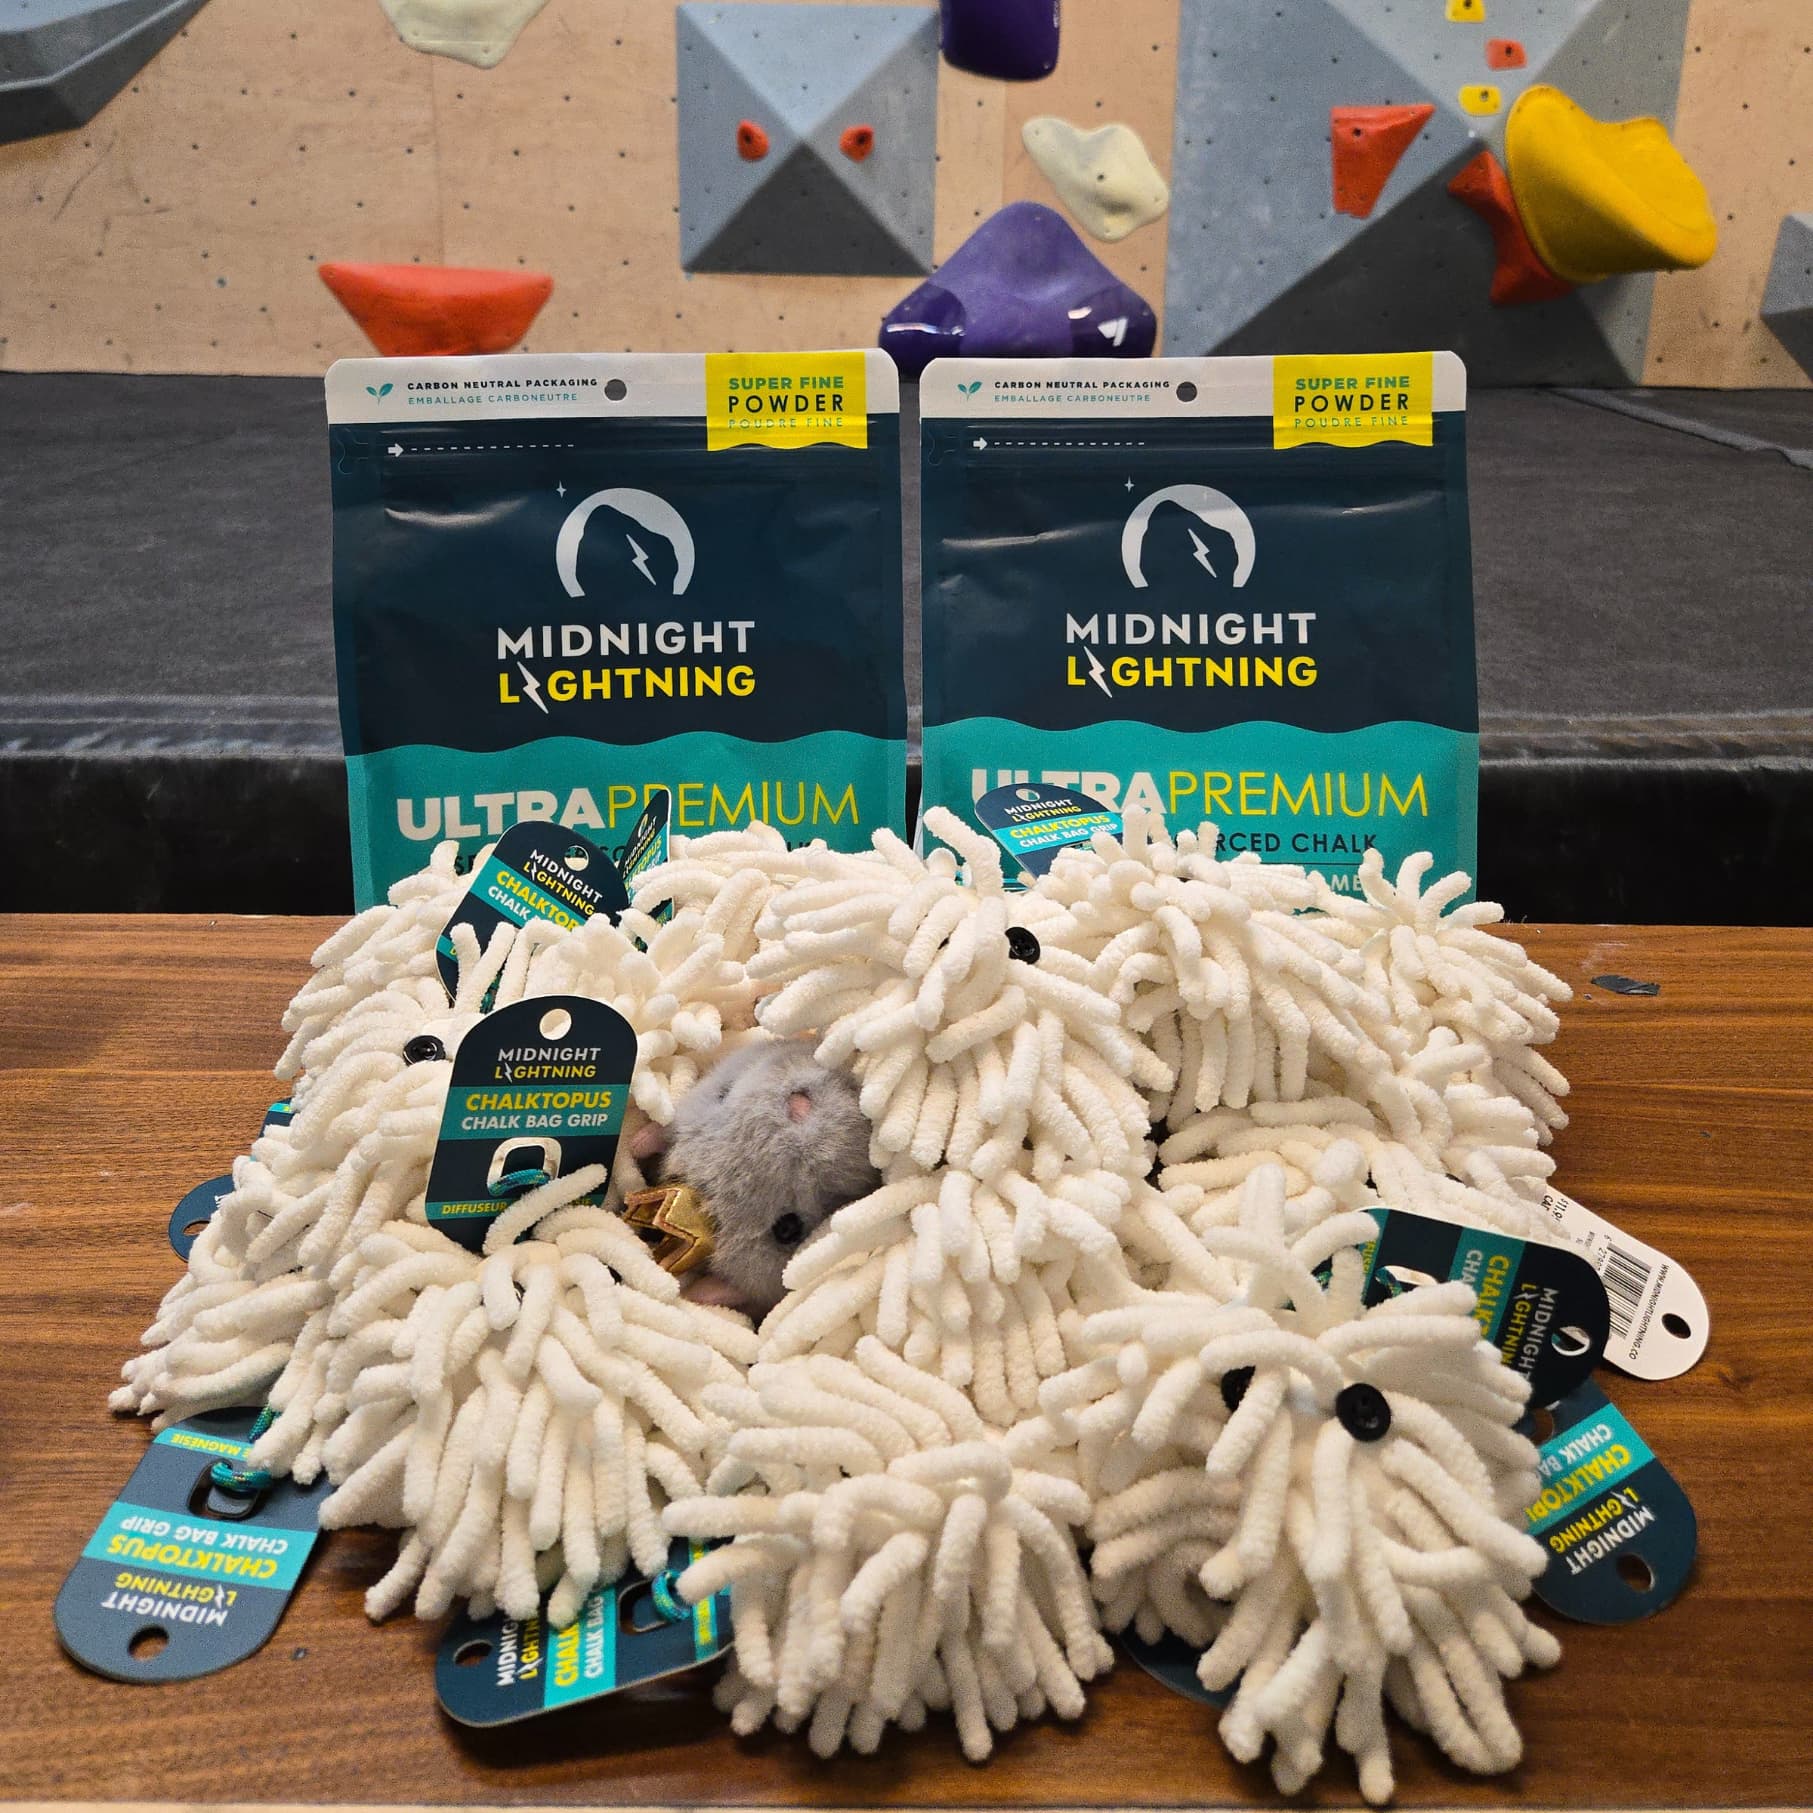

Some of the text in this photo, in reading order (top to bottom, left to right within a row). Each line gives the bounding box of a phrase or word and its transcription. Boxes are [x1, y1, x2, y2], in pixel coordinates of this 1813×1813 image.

[407, 378, 598, 391] CARBON NEUTRAL PACKAGING
[407, 393, 578, 405] EMBALLAGE CARBONEUTRE
[728, 375, 845, 391] SUPER FINE
[994, 380, 1171, 390] CARBON NEUTRAL PACKAGING
[994, 393, 1152, 403] EMBALLAGE CARBONEUTRE
[1295, 375, 1411, 391] SUPER FINE
[728, 393, 846, 414] POWDER
[1294, 393, 1410, 413] POWDER
[728, 415, 845, 430] POUDRE FINE
[1294, 414, 1410, 429] POUDRE FINE
[498, 620, 756, 660] MIDNIGHT
[1066, 612, 1317, 645] MIDNIGHT
[499, 662, 756, 713] LIGHTNING
[1067, 647, 1318, 697] LIGHTNING
[1004, 799, 1073, 815] MIDNIGHT
[1012, 806, 1082, 822] LIGHTNING
[1010, 815, 1110, 839] CHALKTOPUS
[1019, 823, 1119, 848] CHALK BAG GRIP
[1291, 833, 1377, 853] CHALK
[522, 861, 596, 917] LIGHTNING
[529, 849, 603, 903] MIDNIGHT
[488, 886, 531, 921] CHALK
[496, 871, 583, 933] CHALKTOP
[497, 1047, 601, 1063] MIDNIGHT
[495, 1063, 597, 1082] LIGHTNING
[465, 1091, 612, 1111] CHALKTOPUS
[461, 1113, 608, 1131] CHALK BAG GRIP
[1461, 1249, 1483, 1285] CHA
[1501, 1283, 1539, 1365] LIGHTNIN
[1537, 1423, 1613, 1480] CHALK BA
[1525, 1444, 1632, 1522] CHALKTOP
[120, 1516, 288, 1555] CHALK BAG GRIP
[1549, 1487, 1640, 1553] LIGHTNING
[1565, 1504, 1656, 1575] MIDNIGHT
[107, 1534, 279, 1579] CHALKTOPUS
[114, 1572, 237, 1608] LIGHTNING
[101, 1591, 229, 1626] MIDNIGHT
[496, 1620, 519, 1686] MIDNIG
[584, 1627, 604, 1679] CHALK
